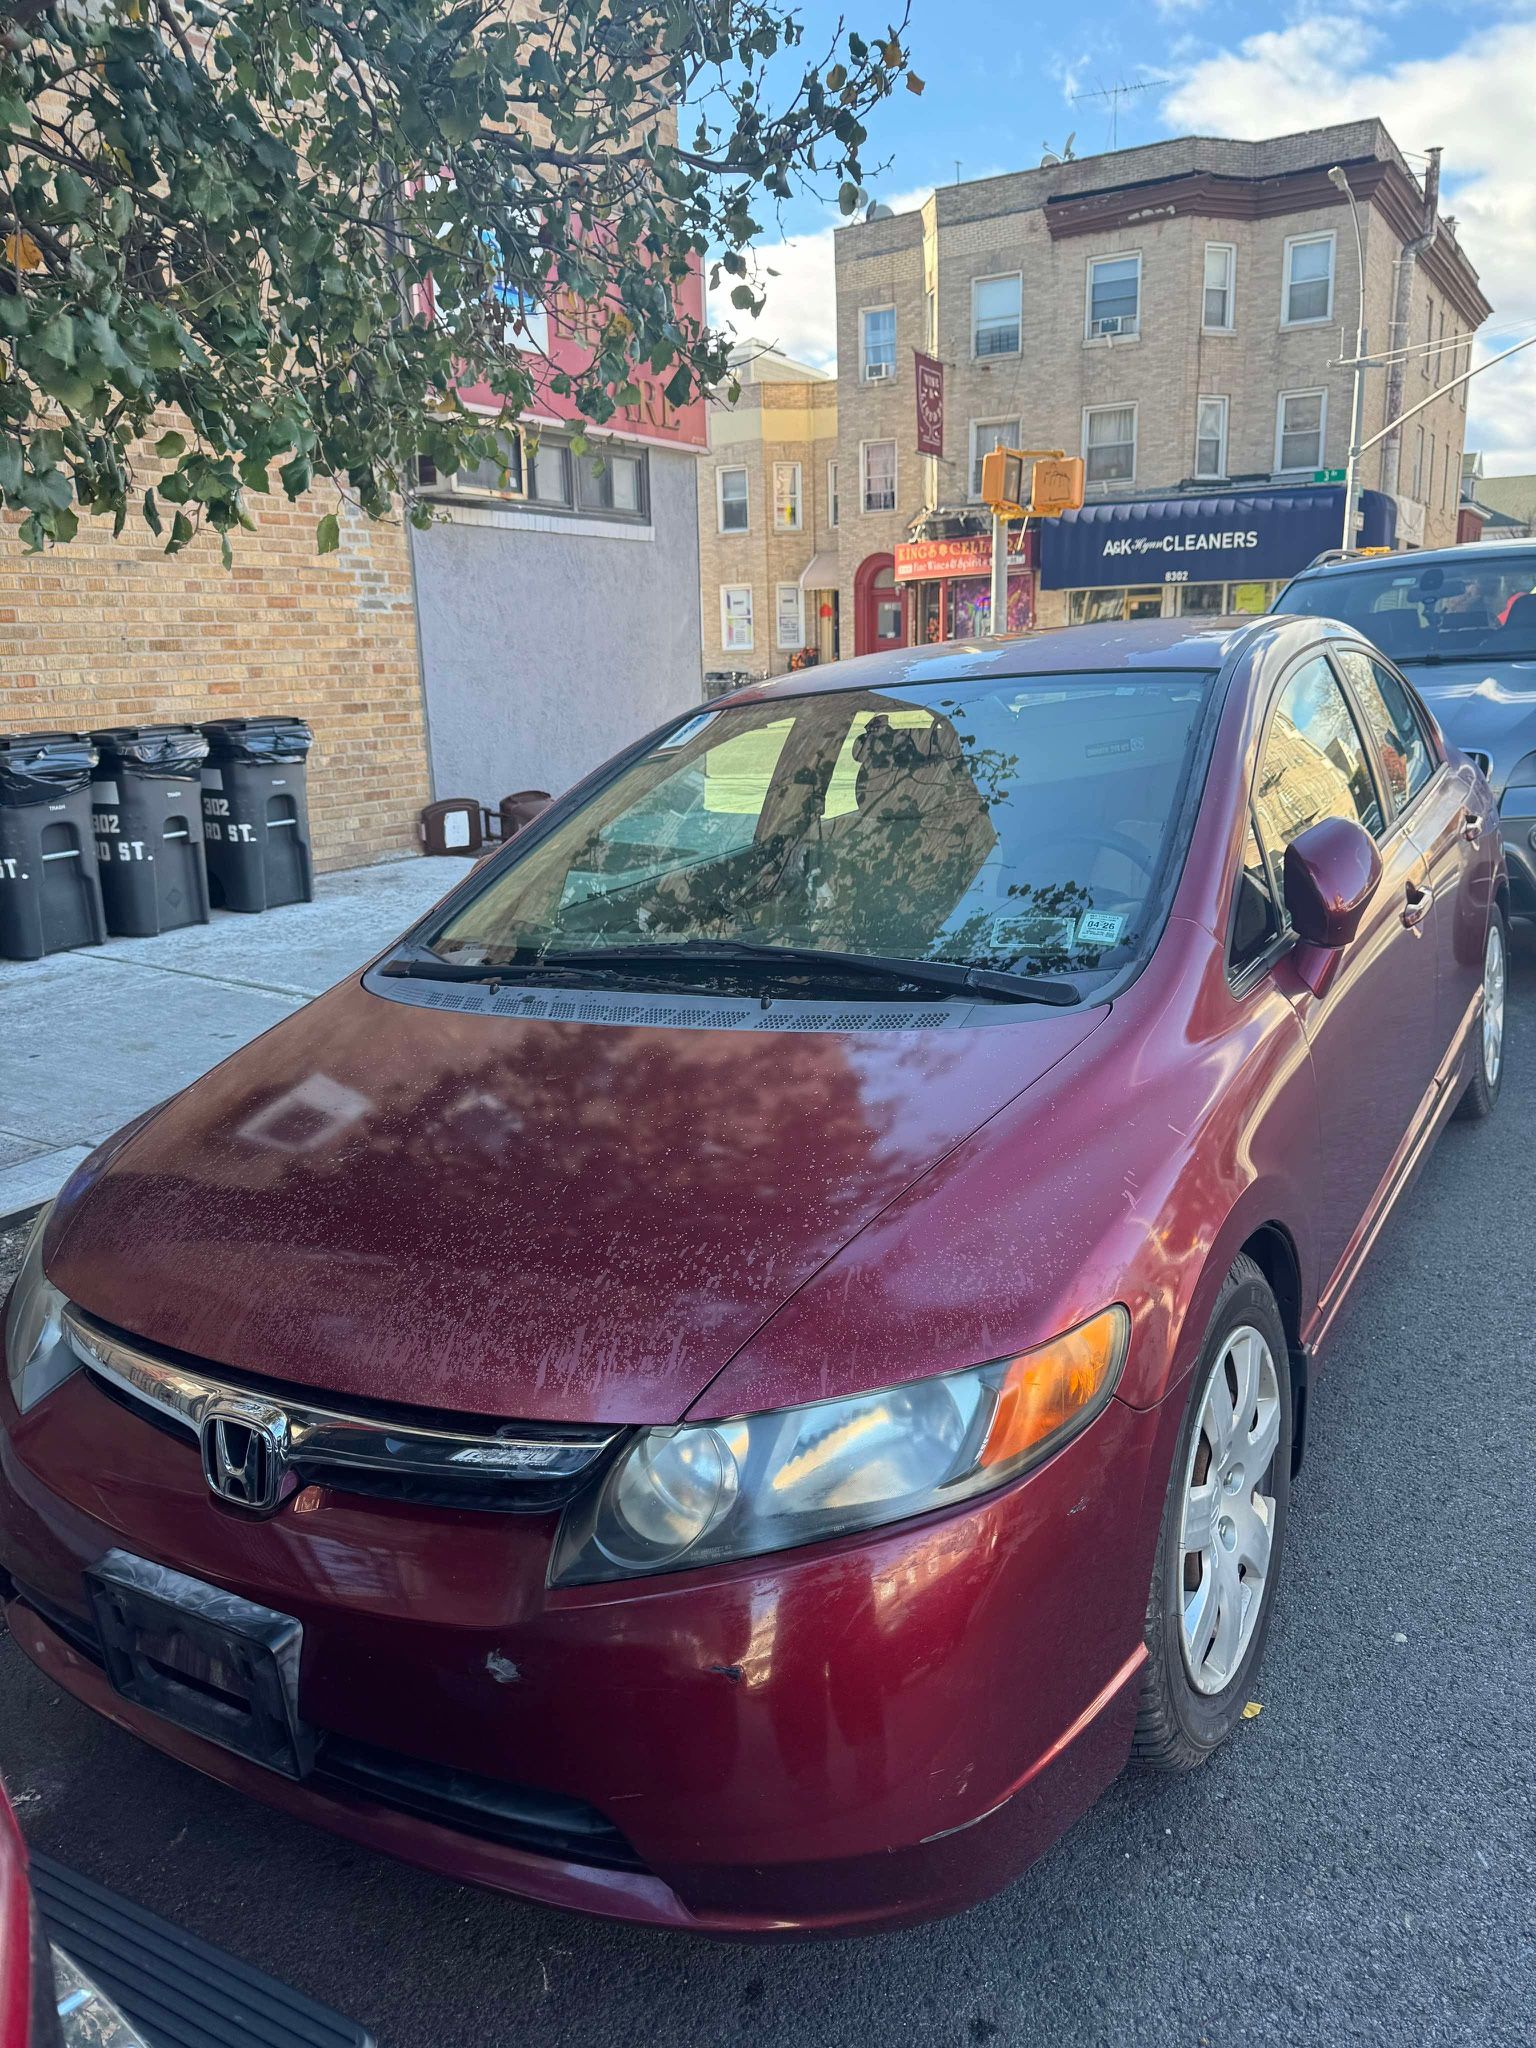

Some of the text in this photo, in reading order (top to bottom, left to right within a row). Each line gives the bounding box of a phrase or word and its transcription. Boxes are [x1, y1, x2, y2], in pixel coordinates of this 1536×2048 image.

[1323, 470, 1330, 481] 3
[1102, 538, 1132, 556] A&K
[1162, 531, 1258, 552] CLEANERS
[1164, 570, 1189, 582] 8302
[203, 798, 230, 816] 302
[228, 823, 257, 843] ST.
[118, 841, 153, 861] ST.
